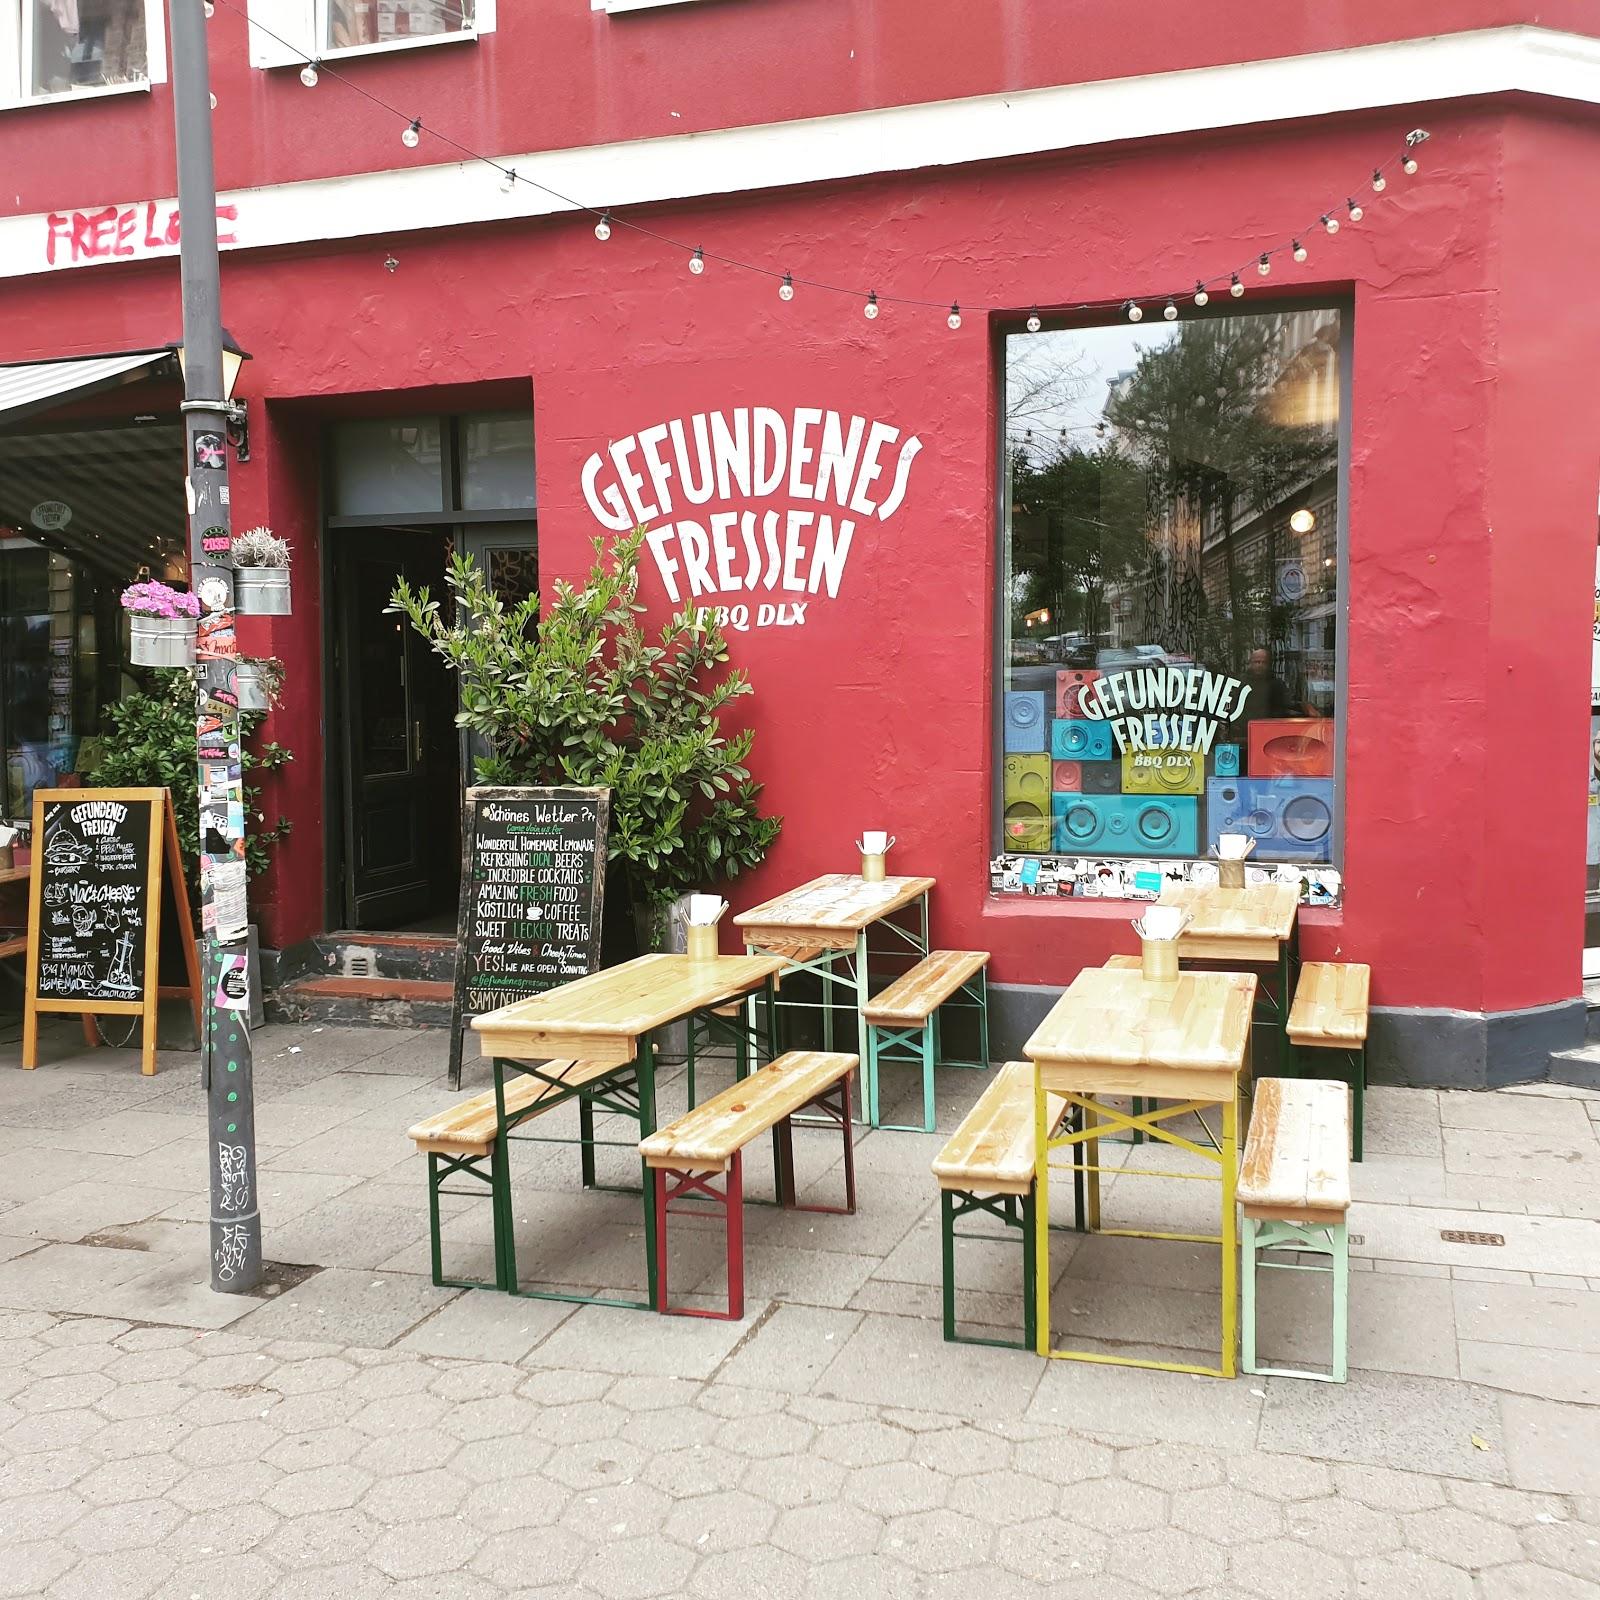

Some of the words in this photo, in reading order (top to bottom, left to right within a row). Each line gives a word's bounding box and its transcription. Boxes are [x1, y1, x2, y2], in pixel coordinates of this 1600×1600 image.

[47, 206, 137, 265] FREE
[580, 407, 923, 531] GEFUNDENES
[645, 510, 856, 603] FRESSEN
[757, 602, 808, 627] DLX
[1077, 667, 1252, 722] GEFUNDENES
[207, 703, 232, 715] SASSI
[1110, 713, 1218, 755] FRESSEN
[1134, 754, 1164, 769] BBQ
[1166, 755, 1192, 767] DLX
[70, 801, 128, 823] GEFUNDENES
[488, 803, 530, 823] Schönes
[535, 804, 579, 823] Wetter
[81, 819, 117, 837] FRESSEN
[477, 833, 518, 851] WONDERFUL
[521, 835, 559, 851] HOMEMADE
[559, 835, 595, 852] LEMONADE
[480, 853, 529, 867] REFRESHING
[529, 853, 553, 867] LOCAL
[555, 853, 584, 868] BEERS
[487, 868, 535, 883] INCREDIBLE
[537, 869, 584, 884] COCKTAILS
[478, 884, 519, 900] AMAZING
[520, 886, 553, 901] FRESH
[553, 886, 578, 902] FOOD
[477, 901, 523, 919] KÖSTLICH
[544, 903, 581, 921] COFFEE
[475, 922, 507, 938] SWEET
[513, 922, 553, 940] LECKER
[481, 940, 505, 954] Good
[507, 941, 532, 956] Vibes
[473, 955, 504, 972] YES!
[506, 962, 518, 973] WE
[520, 964, 535, 973] ARE
[536, 964, 557, 974] OPEN
[469, 991, 496, 1010] SAMY
